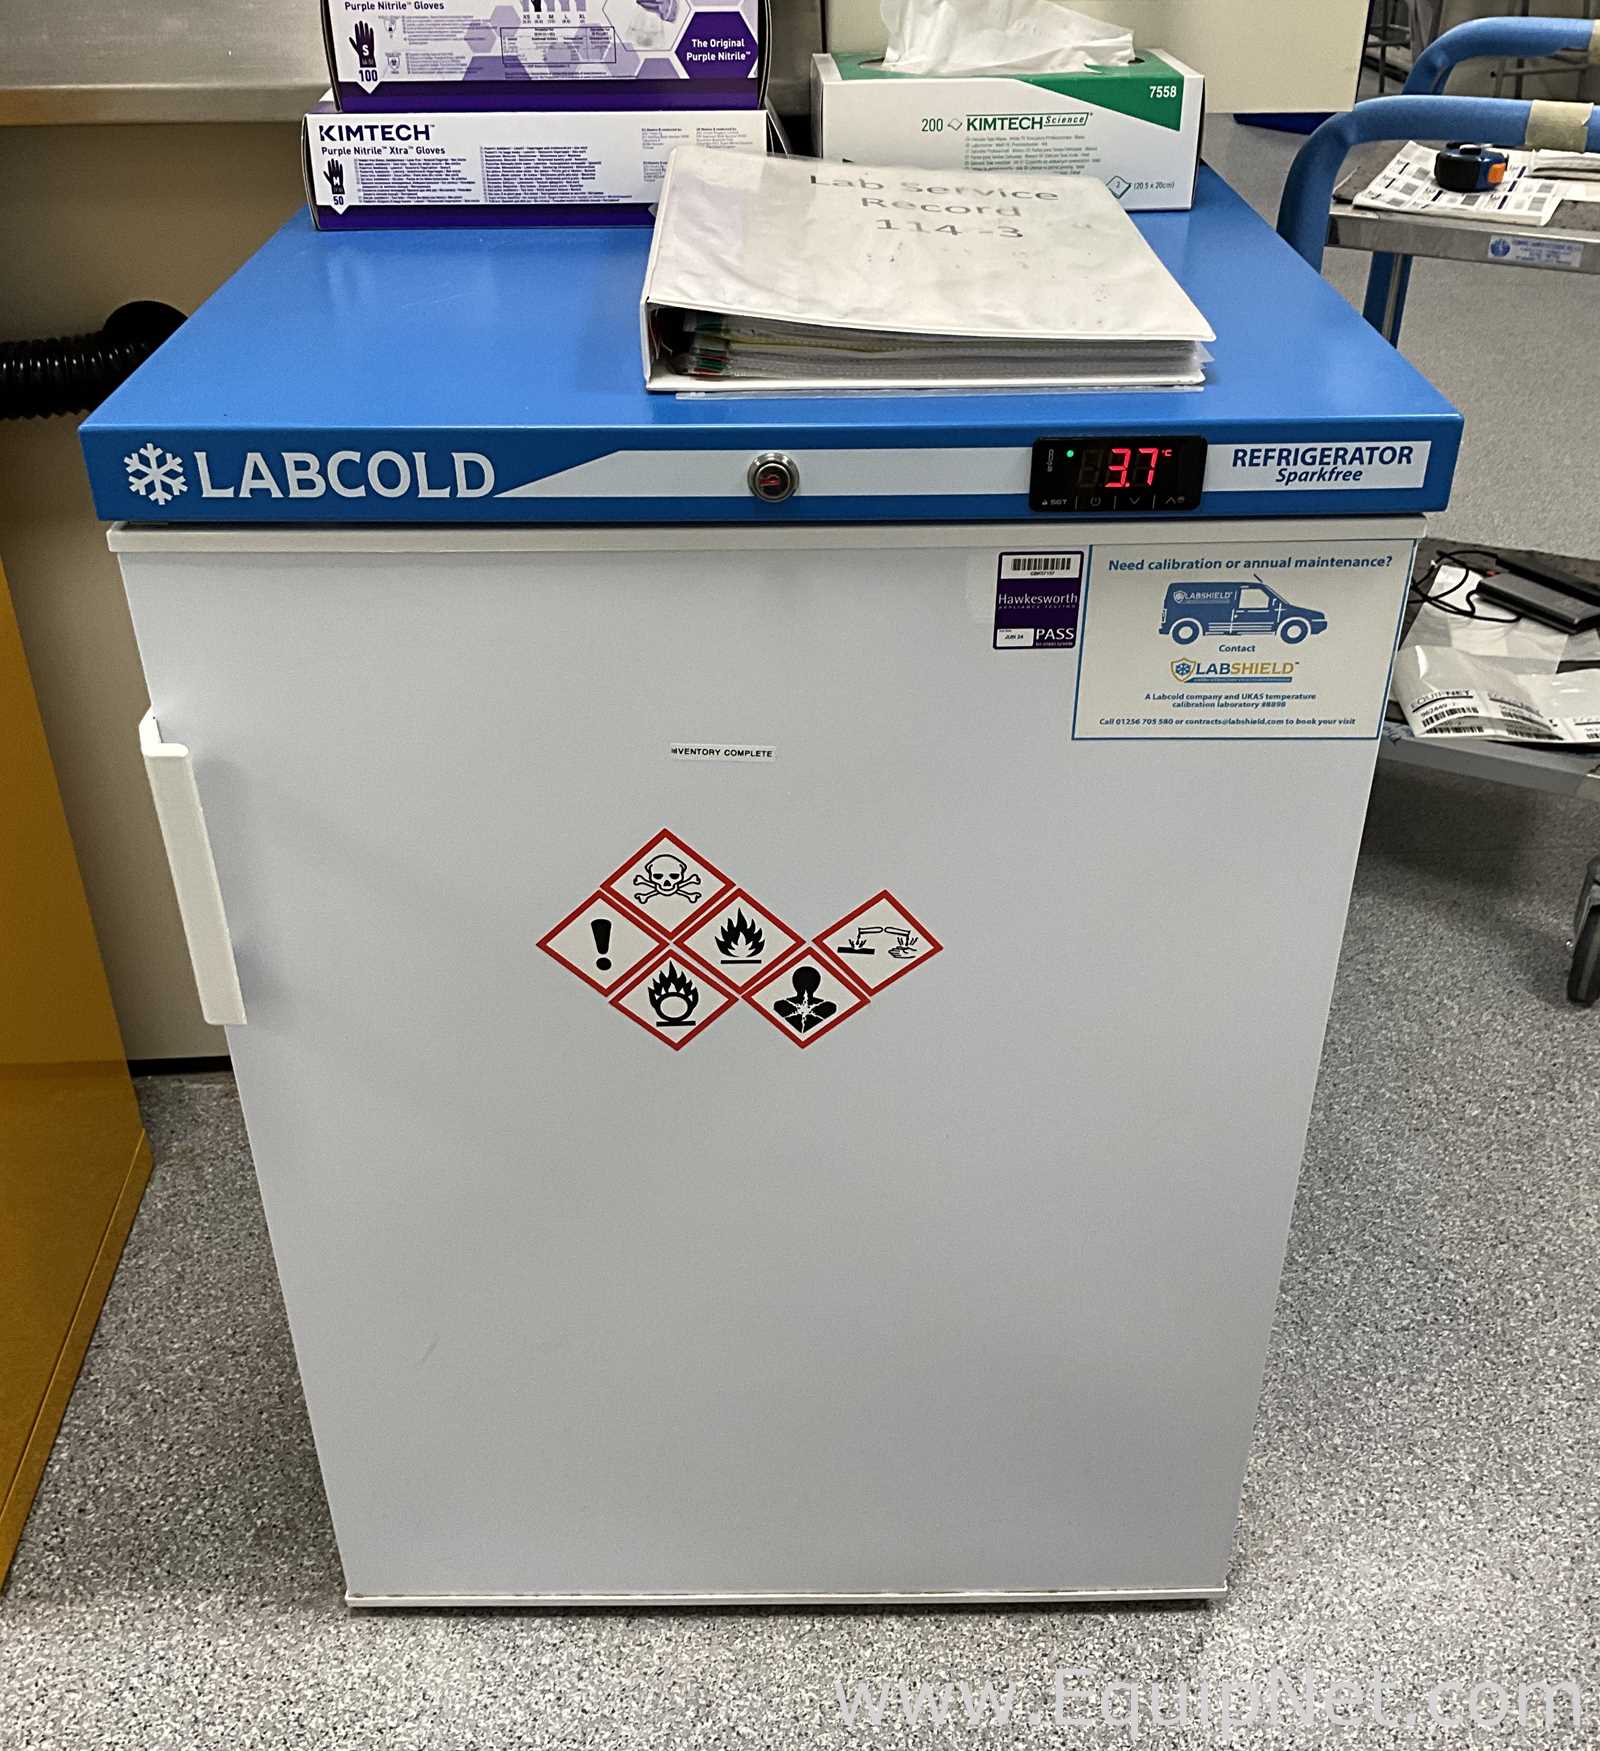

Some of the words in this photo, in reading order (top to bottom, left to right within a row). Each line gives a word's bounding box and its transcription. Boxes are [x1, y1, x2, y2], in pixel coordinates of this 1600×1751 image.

[345, 2, 376, 12] Purple
[414, 1, 445, 10] Gloves
[691, 39, 708, 48] The
[709, 38, 745, 49] Original
[362, 45, 370, 56] S
[687, 52, 716, 63] Purple
[359, 70, 378, 82] 100
[1150, 86, 1177, 98] 7558
[921, 118, 944, 132] 200
[966, 116, 1044, 131] KIMTECH
[1045, 115, 1085, 124] Science
[321, 147, 351, 156] Purple
[416, 146, 446, 155] Gloves
[333, 177, 340, 186] M
[810, 175, 884, 190] Lab
[901, 181, 1059, 200] Service
[333, 196, 344, 205] 50
[861, 197, 1022, 217] Record
[1232, 446, 1414, 467] REFRIGERATOR
[1104, 447, 1159, 487] 3.7
[194, 450, 495, 499] LABCOLD
[1275, 466, 1363, 486] Sparkfree
[1108, 559, 1144, 571] Need
[1148, 558, 1222, 570] calibration
[1225, 560, 1241, 569] or
[1243, 557, 1293, 569] annual
[1295, 556, 1393, 569] maintenance?
[998, 592, 1078, 605] Hawkesworth
[1036, 628, 1075, 640] PASS
[1218, 644, 1256, 653] Contact
[1185, 694, 1220, 702] company
[1265, 693, 1316, 702] temperature
[1217, 701, 1259, 709] laboratory
[724, 749, 773, 757] COMPLETE
